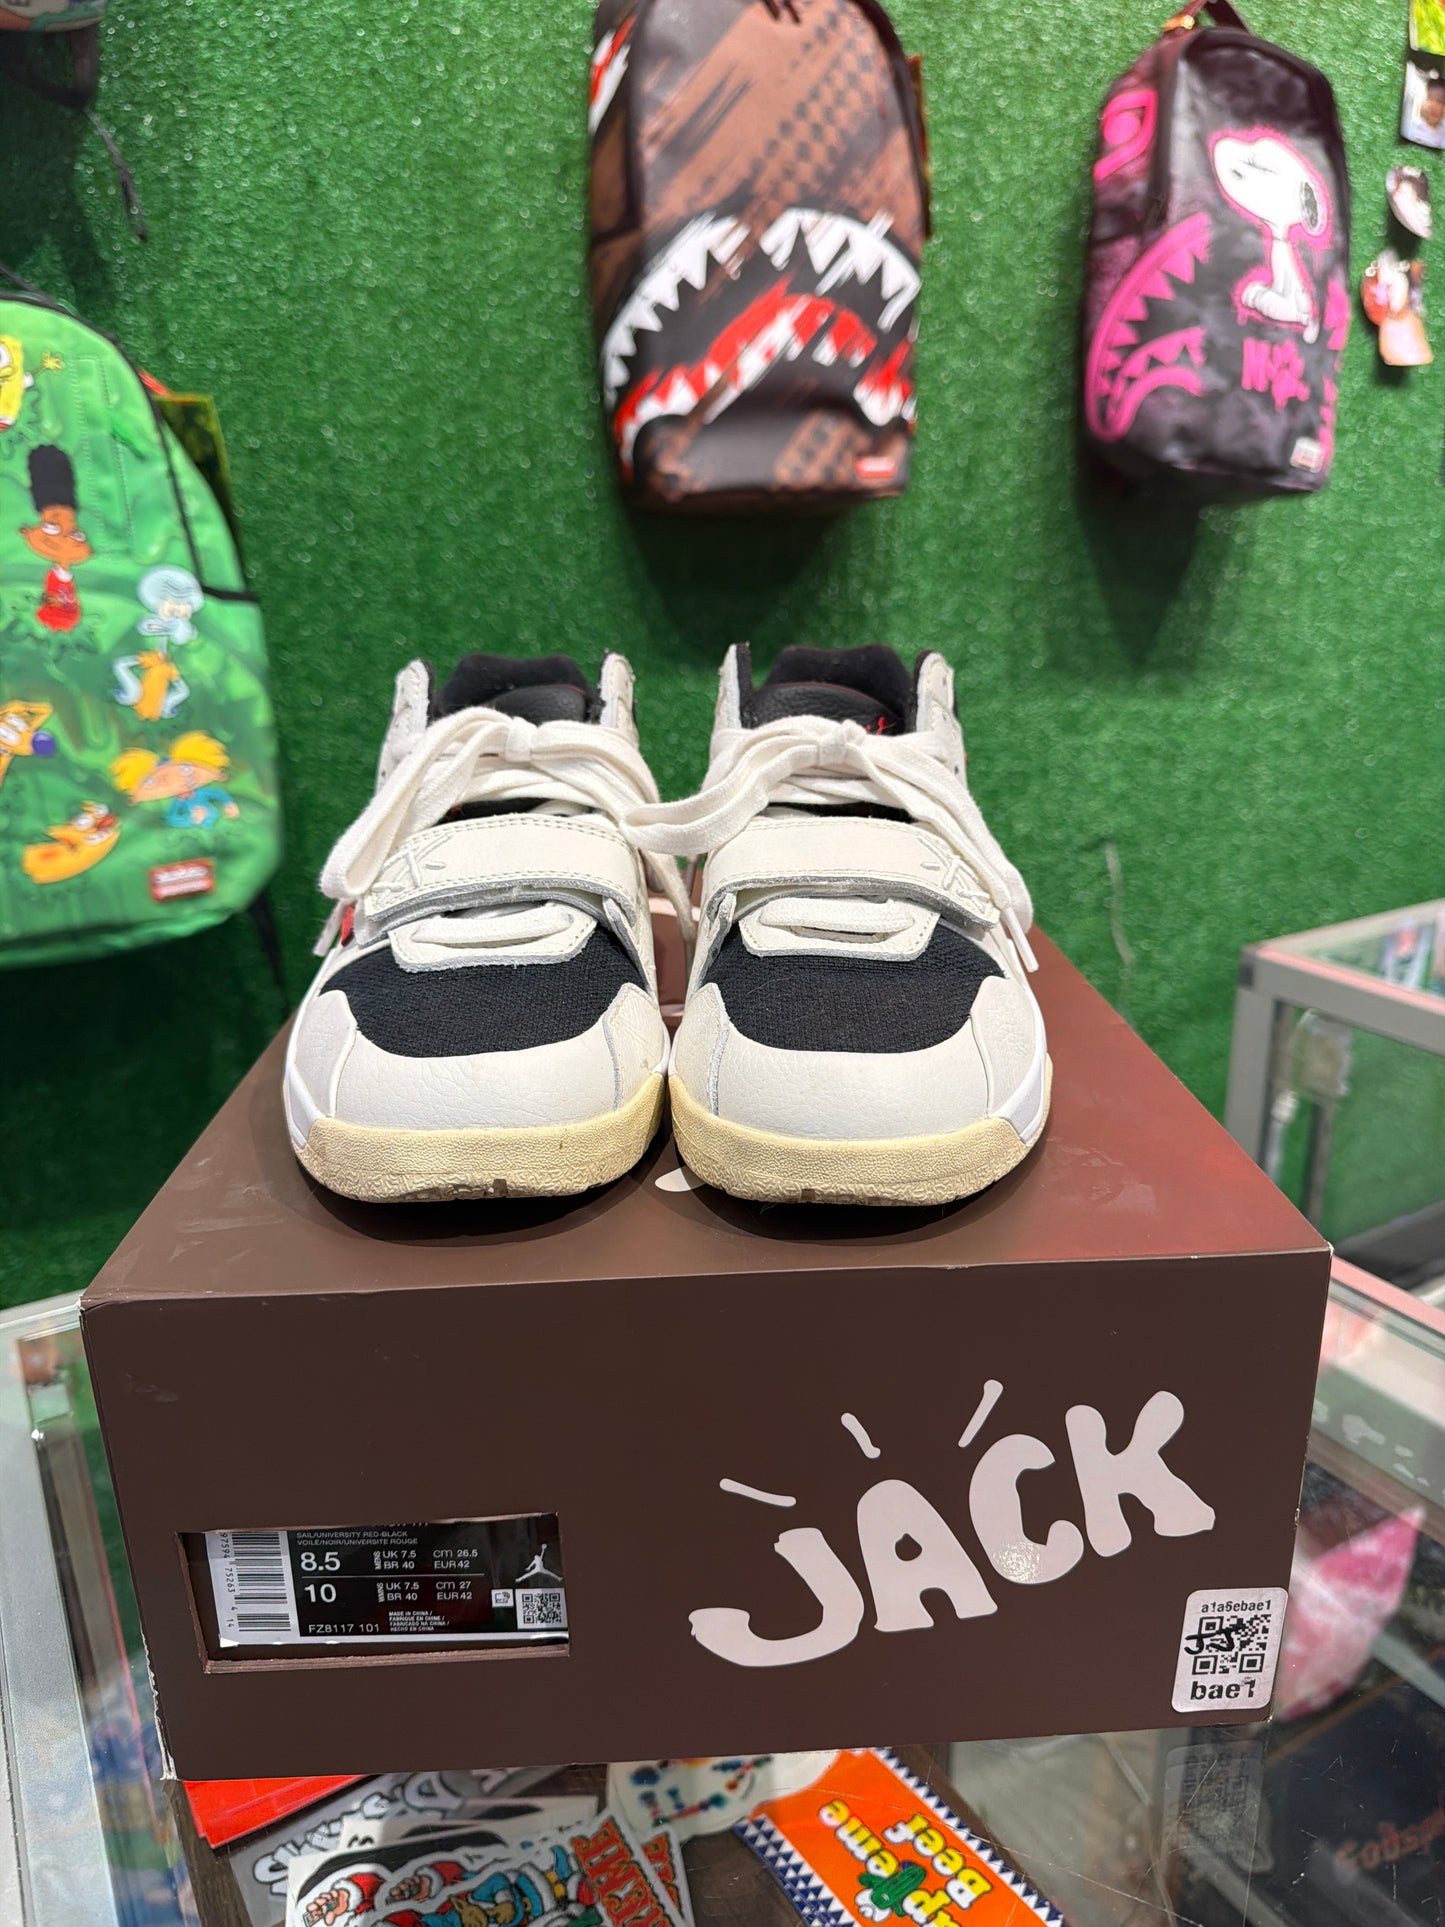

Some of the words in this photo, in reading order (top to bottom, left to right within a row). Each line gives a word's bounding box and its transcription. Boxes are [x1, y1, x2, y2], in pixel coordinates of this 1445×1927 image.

[688, 1390, 1216, 1667] JACK
[296, 1531, 361, 1539] SAIL/UNIVERSITY
[382, 1550, 398, 1559] UK
[401, 1550, 417, 1559] 7.5
[457, 1549, 478, 1558] 26.5
[301, 1551, 341, 1571] 8.5
[383, 1560, 399, 1569] BR
[402, 1560, 415, 1569] 40
[434, 1560, 456, 1569] EUR
[457, 1560, 470, 1569] 42
[225, 1567, 236, 1593] 75263
[385, 1582, 402, 1590] UK
[404, 1582, 420, 1590] 7.5
[459, 1581, 472, 1589] 27
[304, 1583, 337, 1603] 10
[386, 1592, 402, 1601] BR
[405, 1592, 418, 1601] 40
[436, 1592, 459, 1600] EUR
[460, 1592, 473, 1600] 42
[308, 1624, 354, 1633] FZ8117
[359, 1624, 379, 1632] 101
[1190, 1679, 1256, 1700] bae1
[882, 1813, 993, 1910] Beef
